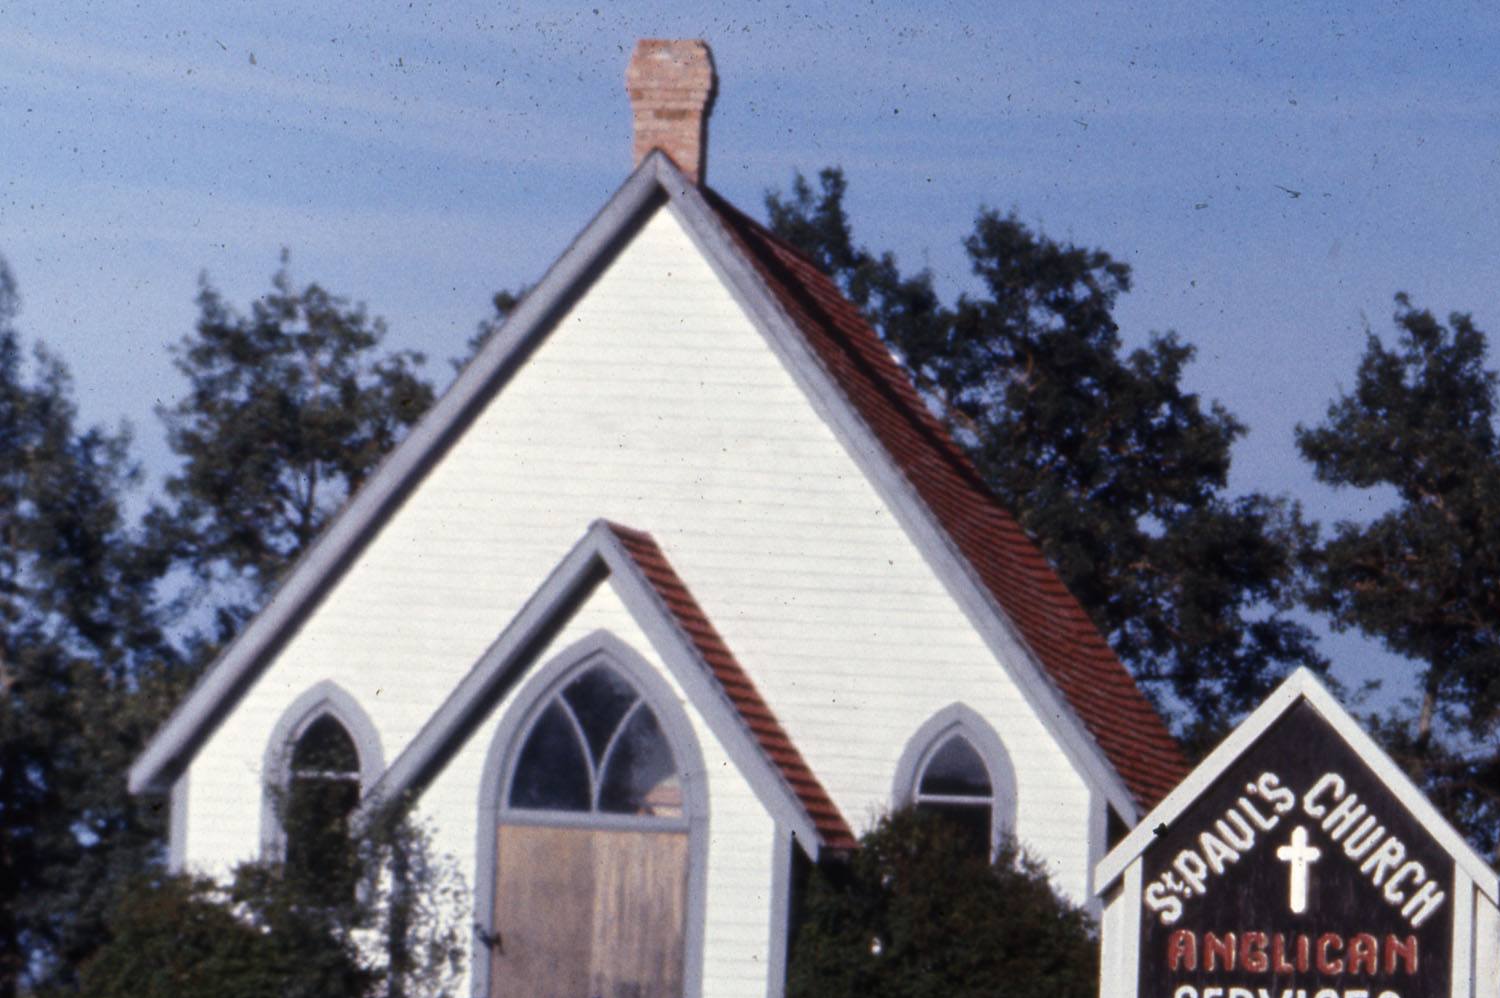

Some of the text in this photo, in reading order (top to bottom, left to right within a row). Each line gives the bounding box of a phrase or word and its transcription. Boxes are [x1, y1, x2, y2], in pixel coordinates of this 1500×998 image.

[1173, 772, 1295, 895] PAUL'S
[1301, 772, 1446, 928] CHURCH
[1168, 929, 1418, 976] ANGLICAN
